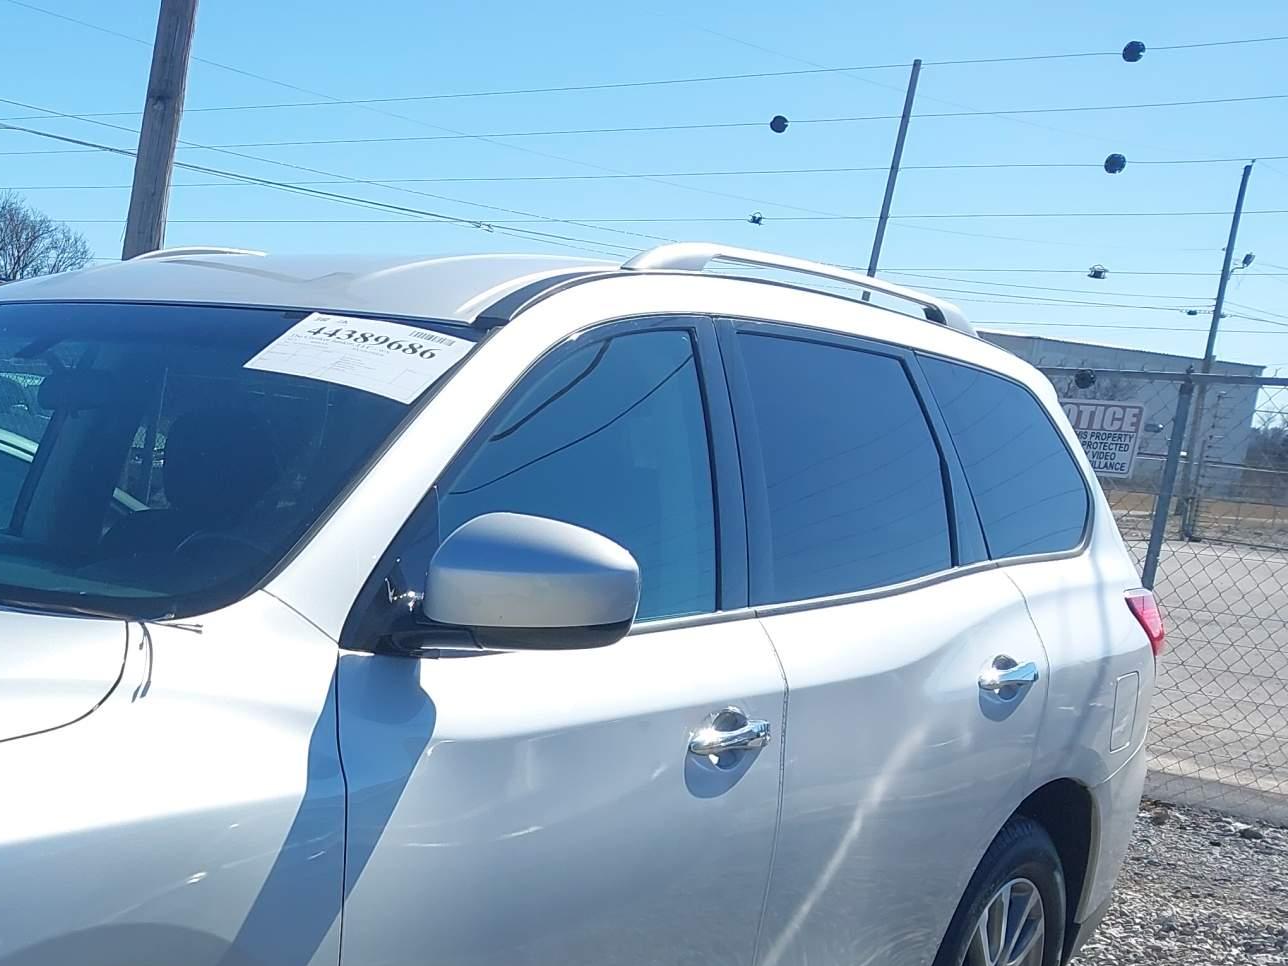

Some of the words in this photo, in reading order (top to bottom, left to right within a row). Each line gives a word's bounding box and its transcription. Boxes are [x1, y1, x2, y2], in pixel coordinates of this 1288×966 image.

[306, 326, 441, 359] 44389686
[1063, 404, 1139, 432] OTICE
[1089, 431, 1134, 443] PROPERTY
[1082, 441, 1130, 452] PROTECTED
[1092, 451, 1117, 461] VIDEO
[1090, 460, 1127, 472] ILLANCE
